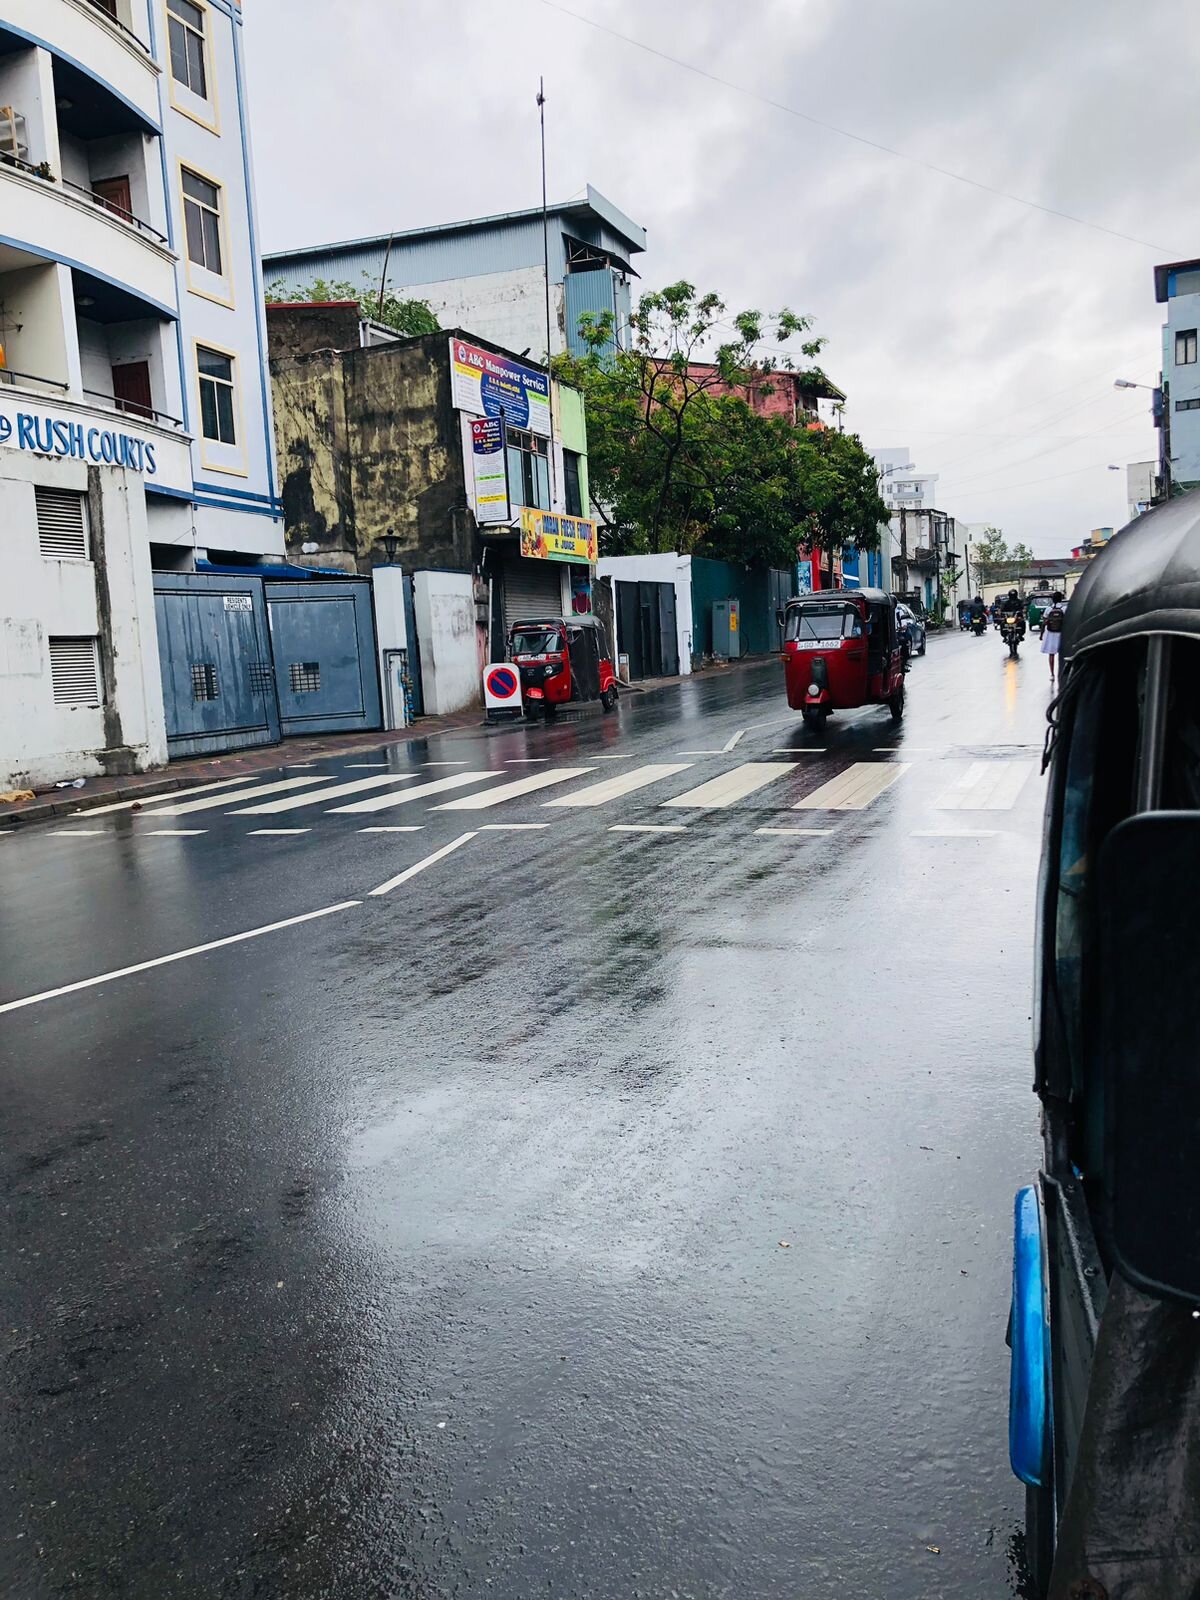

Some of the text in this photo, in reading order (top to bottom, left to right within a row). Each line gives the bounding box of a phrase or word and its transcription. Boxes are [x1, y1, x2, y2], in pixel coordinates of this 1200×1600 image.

[468, 352, 484, 368] ABC
[485, 359, 521, 382] Manpower
[522, 374, 545, 392] Service
[483, 420, 499, 429] ABC
[16, 412, 157, 474] RUSH COURTS
[561, 539, 576, 551] JUICE
